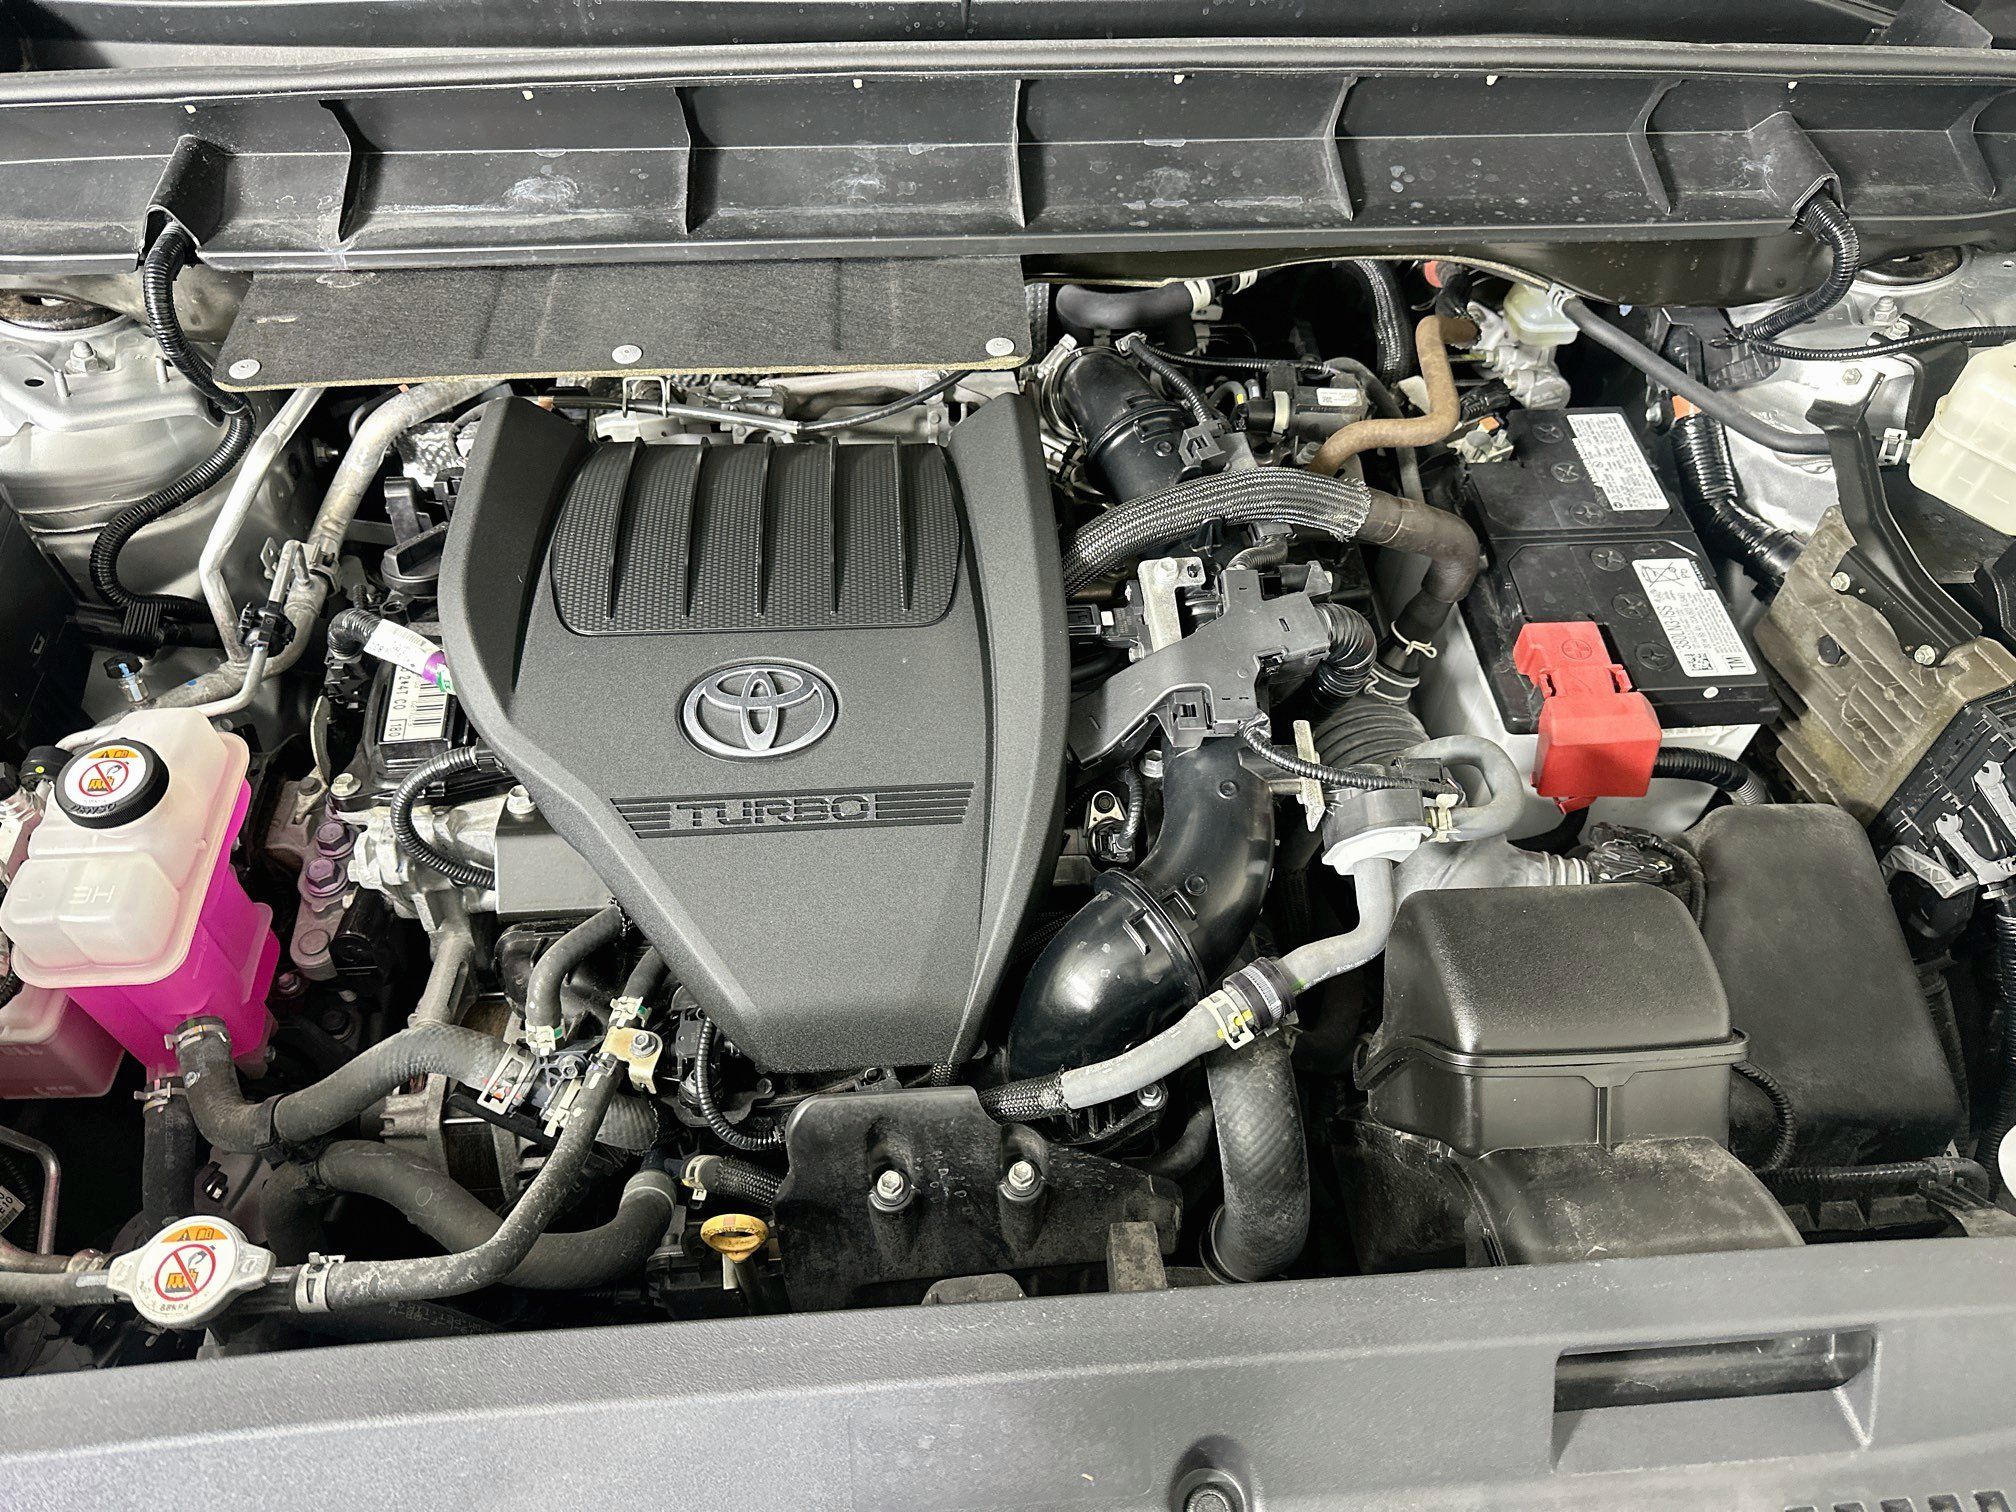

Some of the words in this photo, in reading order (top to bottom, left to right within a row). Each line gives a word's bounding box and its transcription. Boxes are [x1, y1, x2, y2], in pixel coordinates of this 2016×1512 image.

[1725, 656, 1747, 669] TM
[389, 723, 402, 737] 180
[68, 802, 118, 815] DENSO
[676, 795, 869, 827] TURBO
